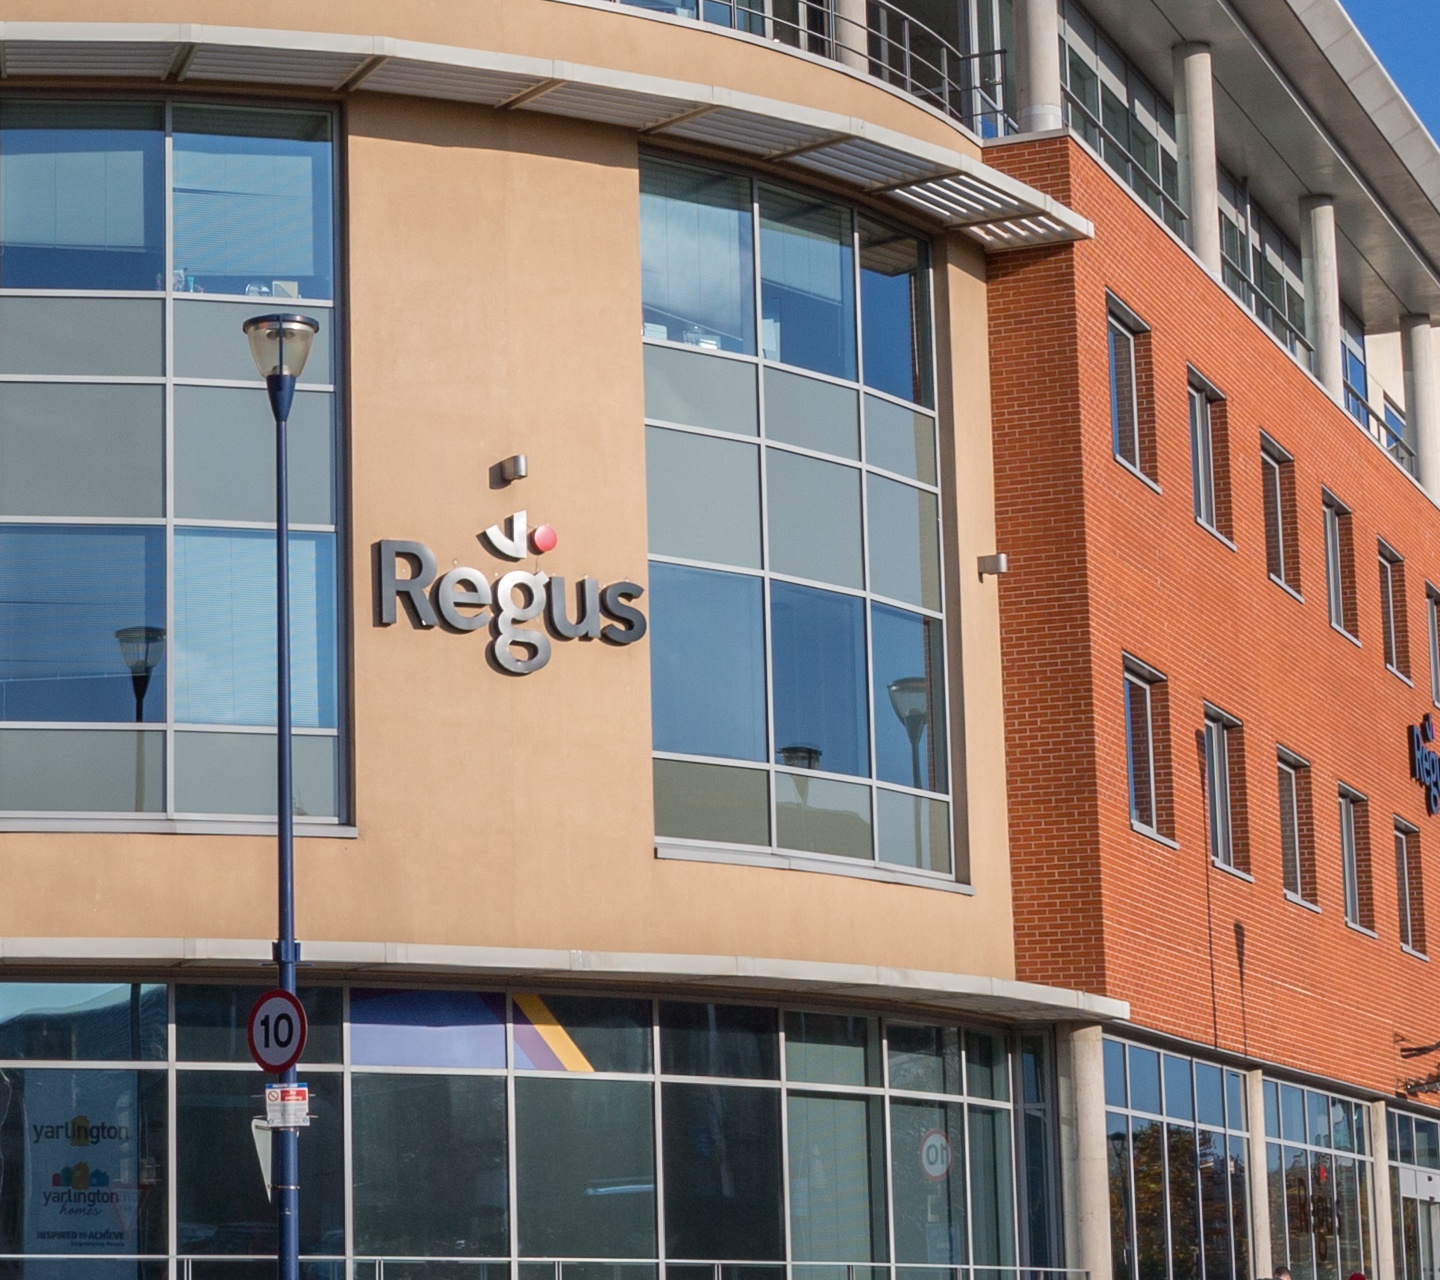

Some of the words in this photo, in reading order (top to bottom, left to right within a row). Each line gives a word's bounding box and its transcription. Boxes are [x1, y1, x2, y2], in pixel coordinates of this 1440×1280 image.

[372, 538, 647, 677] Regus
[260, 1012, 294, 1049] 10
[32, 1122, 129, 1145] yarlington
[42, 1189, 119, 1207] yarlington
